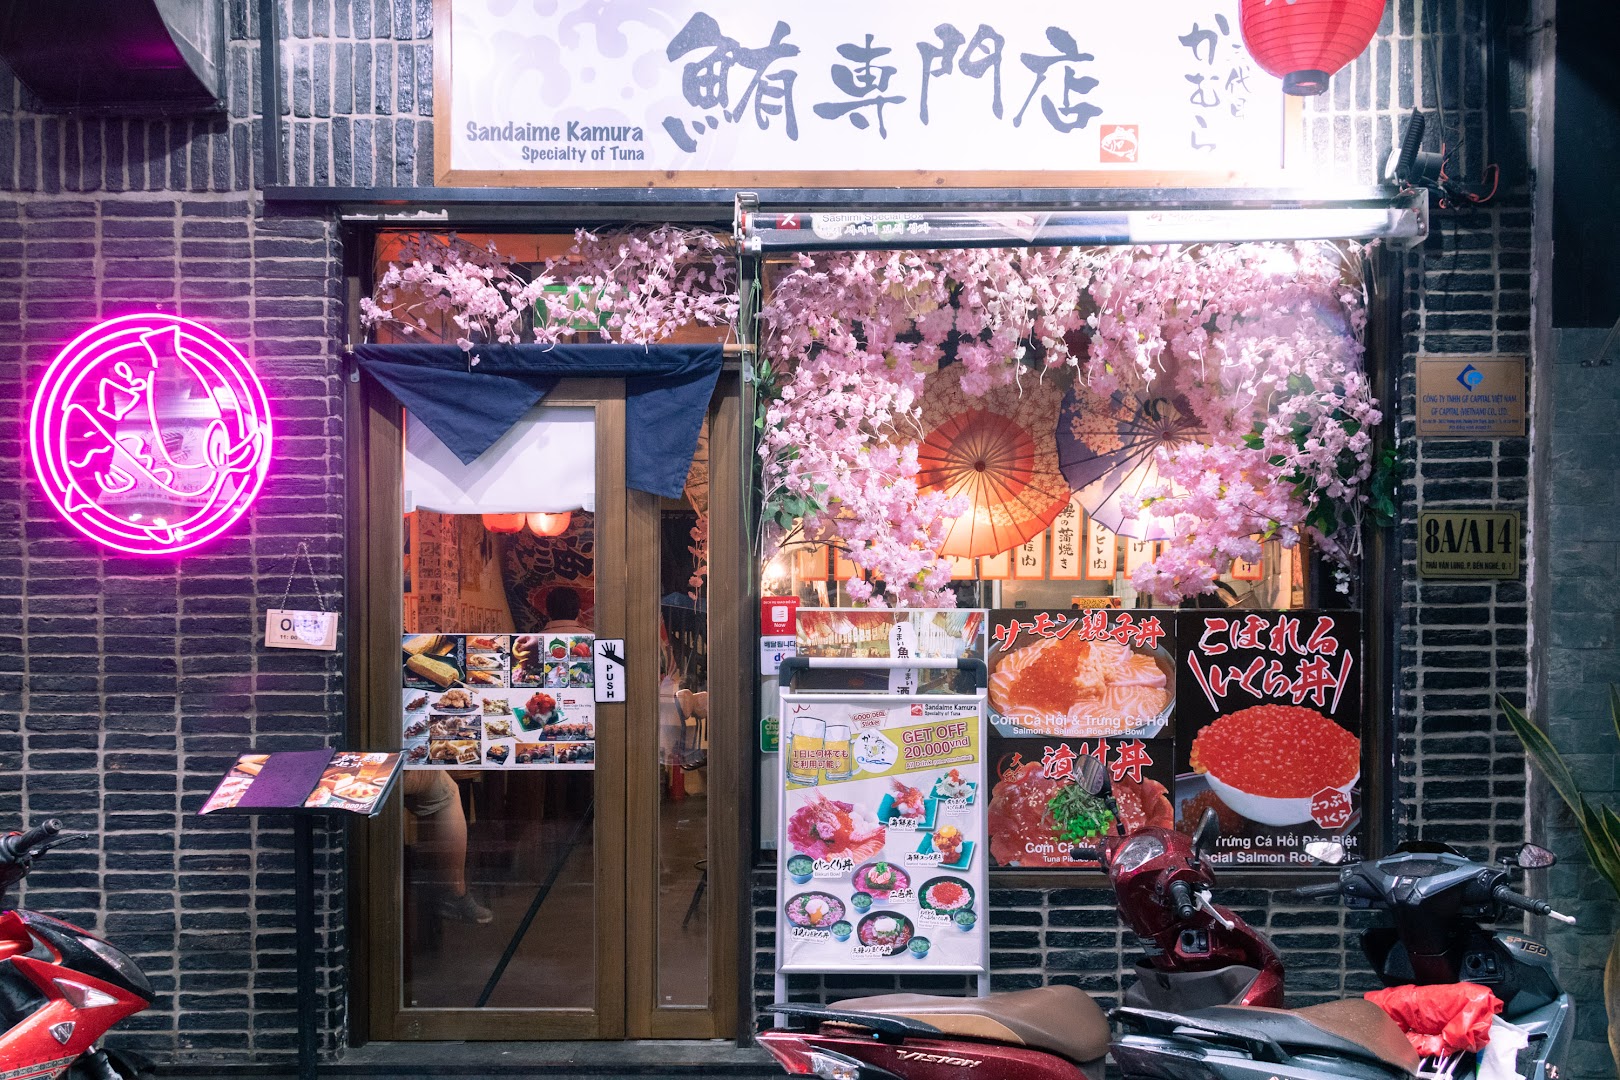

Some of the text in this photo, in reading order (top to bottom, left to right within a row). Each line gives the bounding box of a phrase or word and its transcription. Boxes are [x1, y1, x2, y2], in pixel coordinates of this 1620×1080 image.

[662, 11, 1103, 153] 鮪専門店
[1178, 13, 1230, 152] かむら
[466, 120, 643, 142] Sandaime Kamura
[522, 145, 644, 163] Specialty of Tuna
[822, 214, 862, 222] Sashimi
[864, 214, 901, 223] Special
[1470, 395, 1490, 403] CAPITAL
[1439, 408, 1459, 416] CAPITAL
[1425, 518, 1512, 554] 8A/A14
[992, 609, 1166, 652] サーモン親子丼
[1199, 614, 1339, 656] こぼれる
[606, 664, 614, 698] PUSH
[1209, 655, 1338, 706] いくら丼
[924, 703, 977, 711] Sandaime Kamura
[853, 713, 871, 721] GOOD
[989, 712, 1169, 729] Cơm Cá Hồi & Trứng Cá Hồi
[902, 723, 966, 744] GET OFF
[1013, 726, 1146, 735] Salmon & Salmon Roe Rice Bowl
[1307, 792, 1352, 811] たっぷり
[1317, 809, 1350, 825] いくら
[1255, 833, 1272, 847] Cá
[1277, 832, 1299, 847] Hồi
[814, 859, 853, 872] びっくり丼
[1043, 855, 1061, 863] Tuna
[1236, 851, 1285, 863] Salmon
[1289, 851, 1315, 863] Roe
[896, 1049, 983, 1068] VISION
